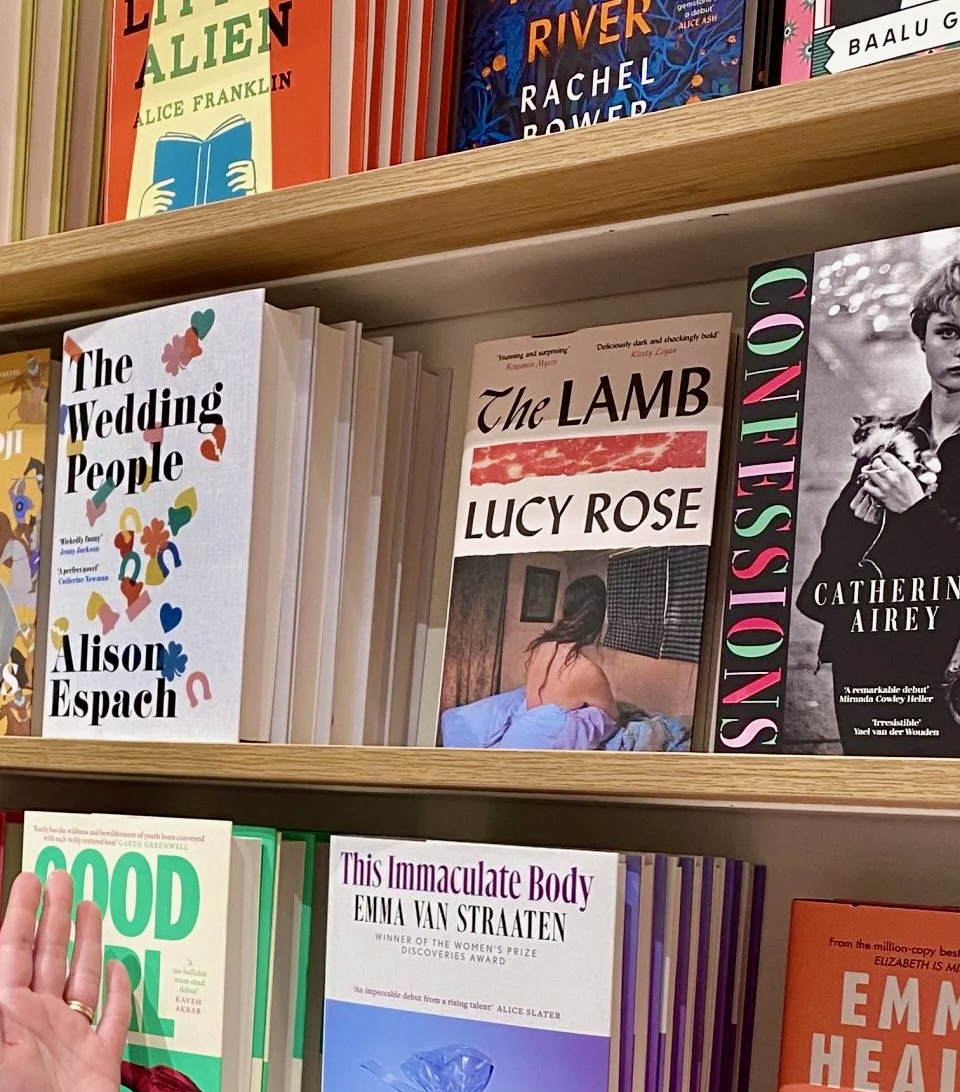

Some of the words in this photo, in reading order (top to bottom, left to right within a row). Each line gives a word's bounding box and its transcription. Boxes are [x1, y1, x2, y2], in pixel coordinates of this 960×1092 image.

[135, 1, 293, 90] ALIEN
[528, 0, 651, 63] RIVER
[678, 18, 700, 30] ALICE
[701, 14, 718, 25] ASH
[848, 18, 927, 56] BAALU
[133, 102, 184, 129] ALICE
[193, 71, 292, 113] FRANKLIN
[521, 58, 655, 112] RACHEL
[69, 348, 133, 393] The
[66, 381, 224, 443] Wedding
[477, 385, 550, 436] The
[557, 366, 711, 428] LAMB
[65, 441, 183, 496] People
[464, 494, 572, 541] LUCY
[583, 487, 703, 534] ROSE
[721, 267, 808, 750] CONFESSIONS
[814, 574, 960, 607] CATHERIN
[850, 606, 941, 634] AIREY
[51, 633, 165, 675] Alison
[48, 678, 177, 727] Espach
[839, 694, 874, 703] Miranda
[875, 694, 905, 705] Cowley
[907, 694, 934, 703] Heller
[340, 850, 383, 888] This
[387, 855, 522, 900] Immaculate
[528, 864, 595, 913] Body
[353, 894, 405, 927] EMMA
[414, 899, 449, 932] VAN
[457, 903, 567, 943] STRAATEN
[375, 932, 412, 945] WINNER
[415, 937, 429, 946] OF
[432, 938, 450, 949] THE
[454, 940, 503, 955] WOMEN'S
[506, 946, 538, 958] PRIZE
[401, 946, 466, 961] DISCOVERIES
[469, 954, 507, 966] AWARD
[829, 937, 853, 948] From
[856, 938, 871, 949] the
[874, 941, 936, 958] million-copy
[939, 945, 960, 958] best
[874, 955, 929, 971] ELIZABETH
[932, 961, 943, 972] IS
[175, 995, 202, 1006] KAVEH
[175, 1005, 202, 1015] AKBAR
[840, 970, 960, 1037] EMM
